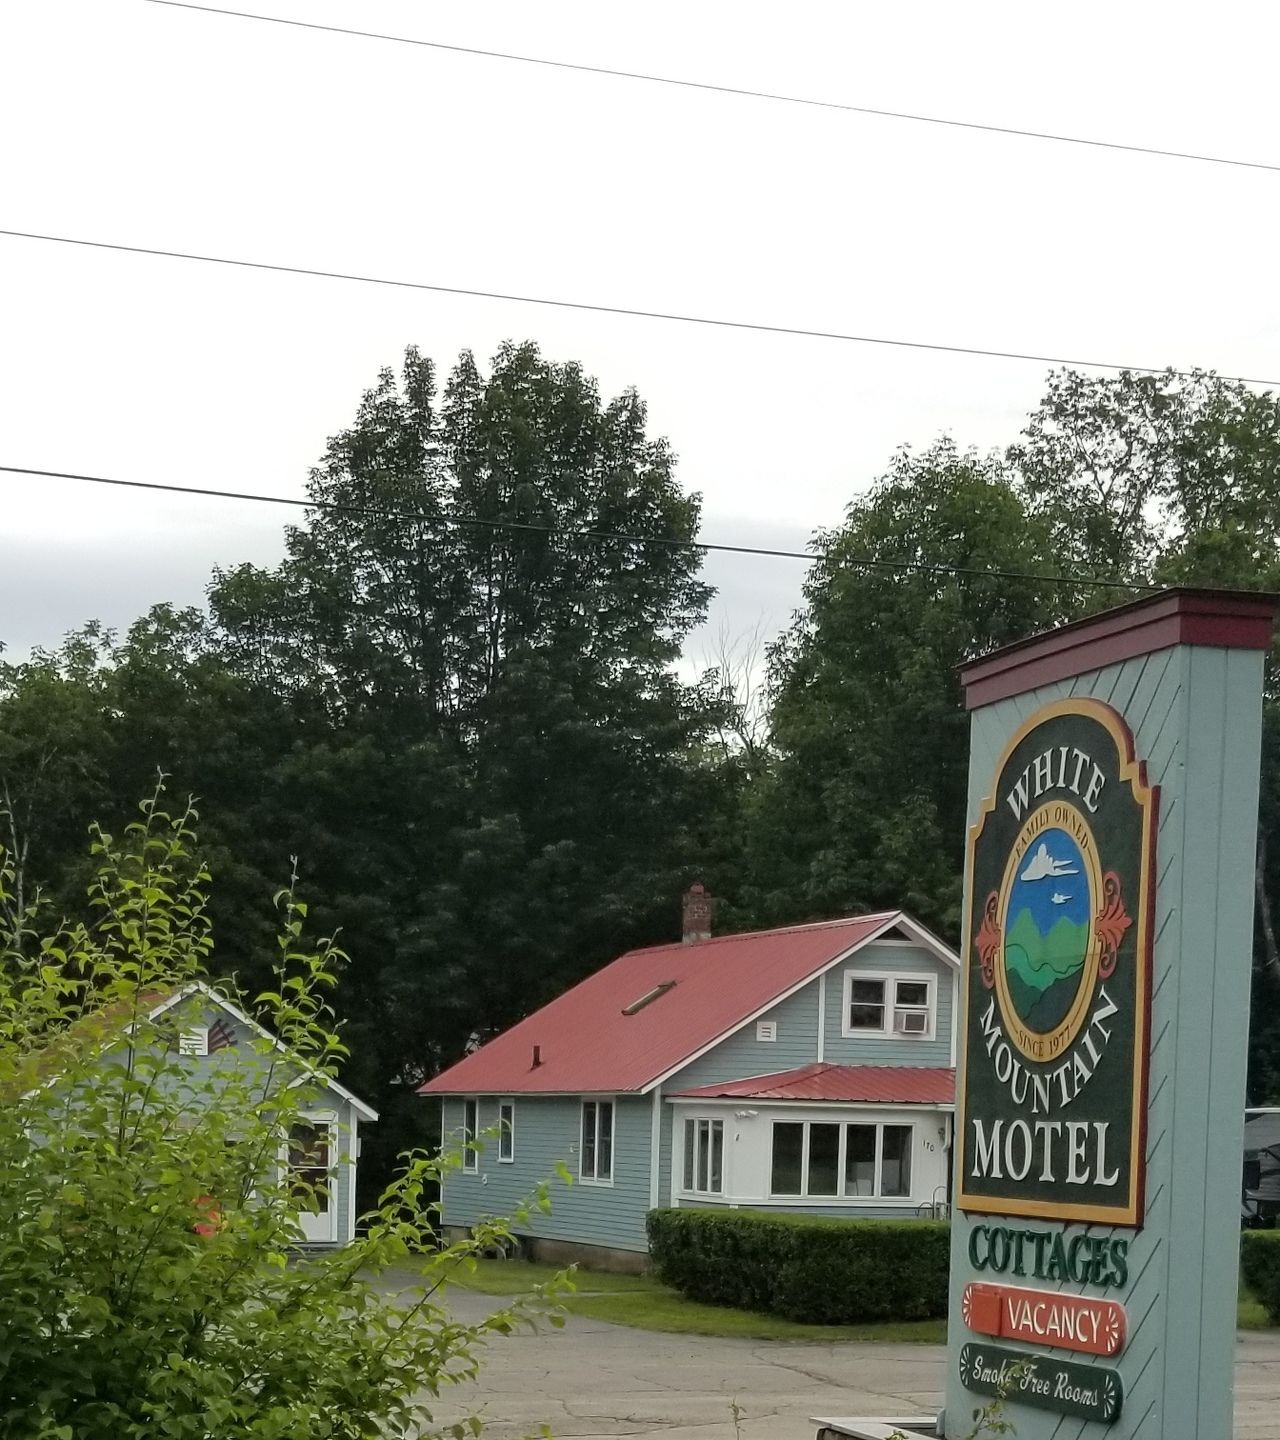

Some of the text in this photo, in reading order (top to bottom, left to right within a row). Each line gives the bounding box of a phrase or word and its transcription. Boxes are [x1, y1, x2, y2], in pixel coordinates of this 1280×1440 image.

[1006, 746, 1106, 822] WHITE
[1014, 806, 1090, 858] FAMILY OWNED
[979, 984, 1119, 1115] MOUNTAIN
[1017, 1024, 1070, 1057] SINCE 1977
[922, 1139, 936, 1153] 170
[971, 1119, 1120, 1187] MOTEL
[968, 1224, 1130, 1288] COTTAGES
[1008, 1296, 1103, 1344] VACANCY
[1053, 1371, 1099, 1407] Rooms
